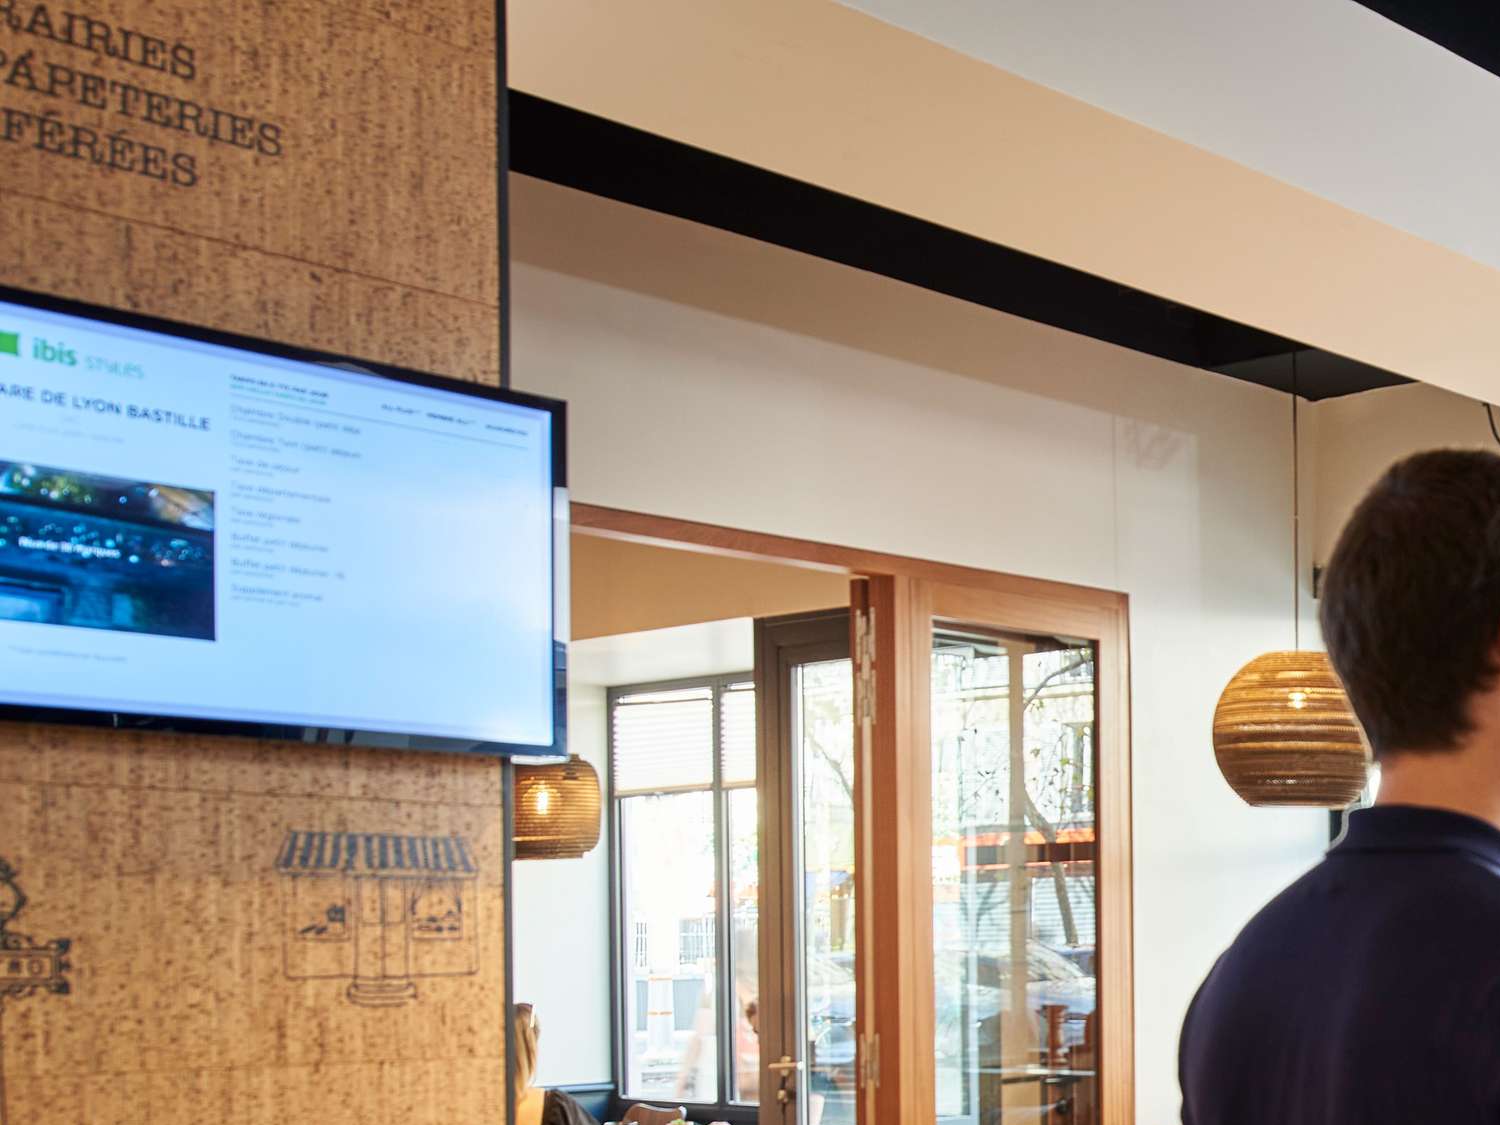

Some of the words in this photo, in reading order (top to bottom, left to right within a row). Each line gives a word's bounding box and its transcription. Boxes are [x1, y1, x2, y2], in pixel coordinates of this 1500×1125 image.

[32, 337, 78, 366] ibis
[40, 388, 67, 406] DE
[71, 395, 121, 417] LYON
[126, 404, 211, 431] BASTILLE
